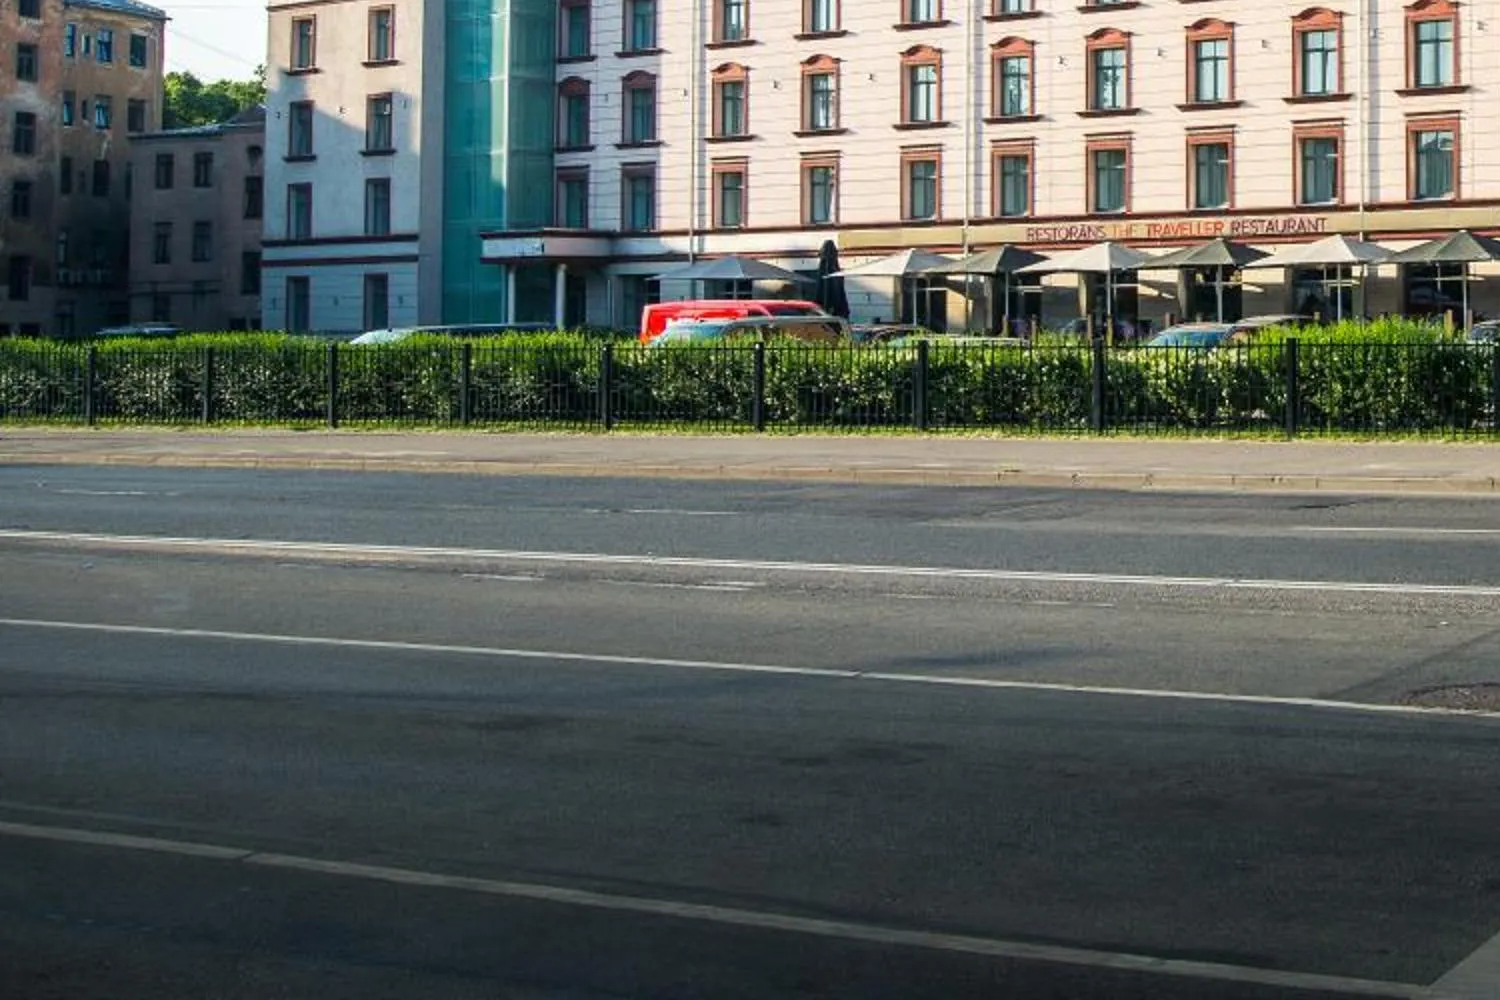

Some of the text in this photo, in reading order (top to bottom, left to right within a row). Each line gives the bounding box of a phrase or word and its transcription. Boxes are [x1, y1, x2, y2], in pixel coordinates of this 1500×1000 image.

[1112, 223, 1136, 239] THE
[1145, 219, 1225, 238] TRAVELLER
[1230, 217, 1328, 234] RESTAURANT
